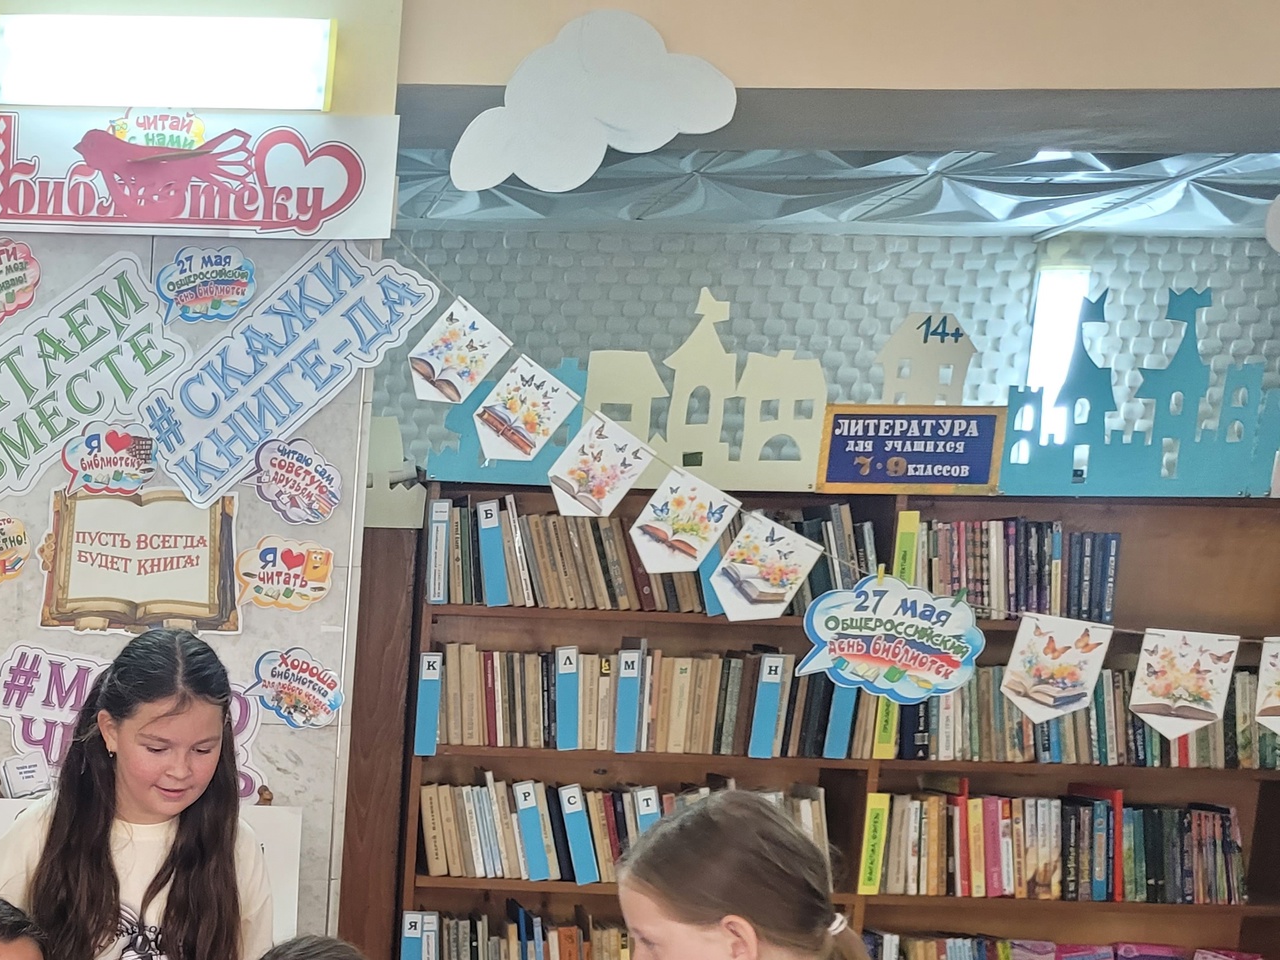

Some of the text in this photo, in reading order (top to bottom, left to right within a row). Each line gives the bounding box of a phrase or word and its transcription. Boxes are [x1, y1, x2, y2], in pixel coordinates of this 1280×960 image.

[177, 255, 193, 274] 27
[916, 315, 963, 344] 14+
[175, 275, 425, 495] КНИГЕ-ДА
[834, 420, 979, 437] ЛИТЕРАТУРА
[85, 433, 101, 456] Я
[884, 440, 965, 453] УЧАЩИХСЯ
[81, 454, 143, 471] библиотеку
[483, 509, 494, 520] Б
[75, 530, 208, 550] ПУСТЬ ВСЕГДА
[77, 550, 200, 576] БУДЕТ КНИГА!
[259, 547, 277, 570] Я
[854, 589, 952, 628] 27 мая
[426, 660, 437, 670] К
[562, 654, 573, 666] Л
[624, 660, 636, 670] М
[871, 635, 954, 679] библиотек
[767, 665, 778, 676] Н
[523, 791, 531, 801] Р
[567, 795, 577, 806] С
[643, 797, 652, 807] Т
[408, 921, 417, 930] Я
